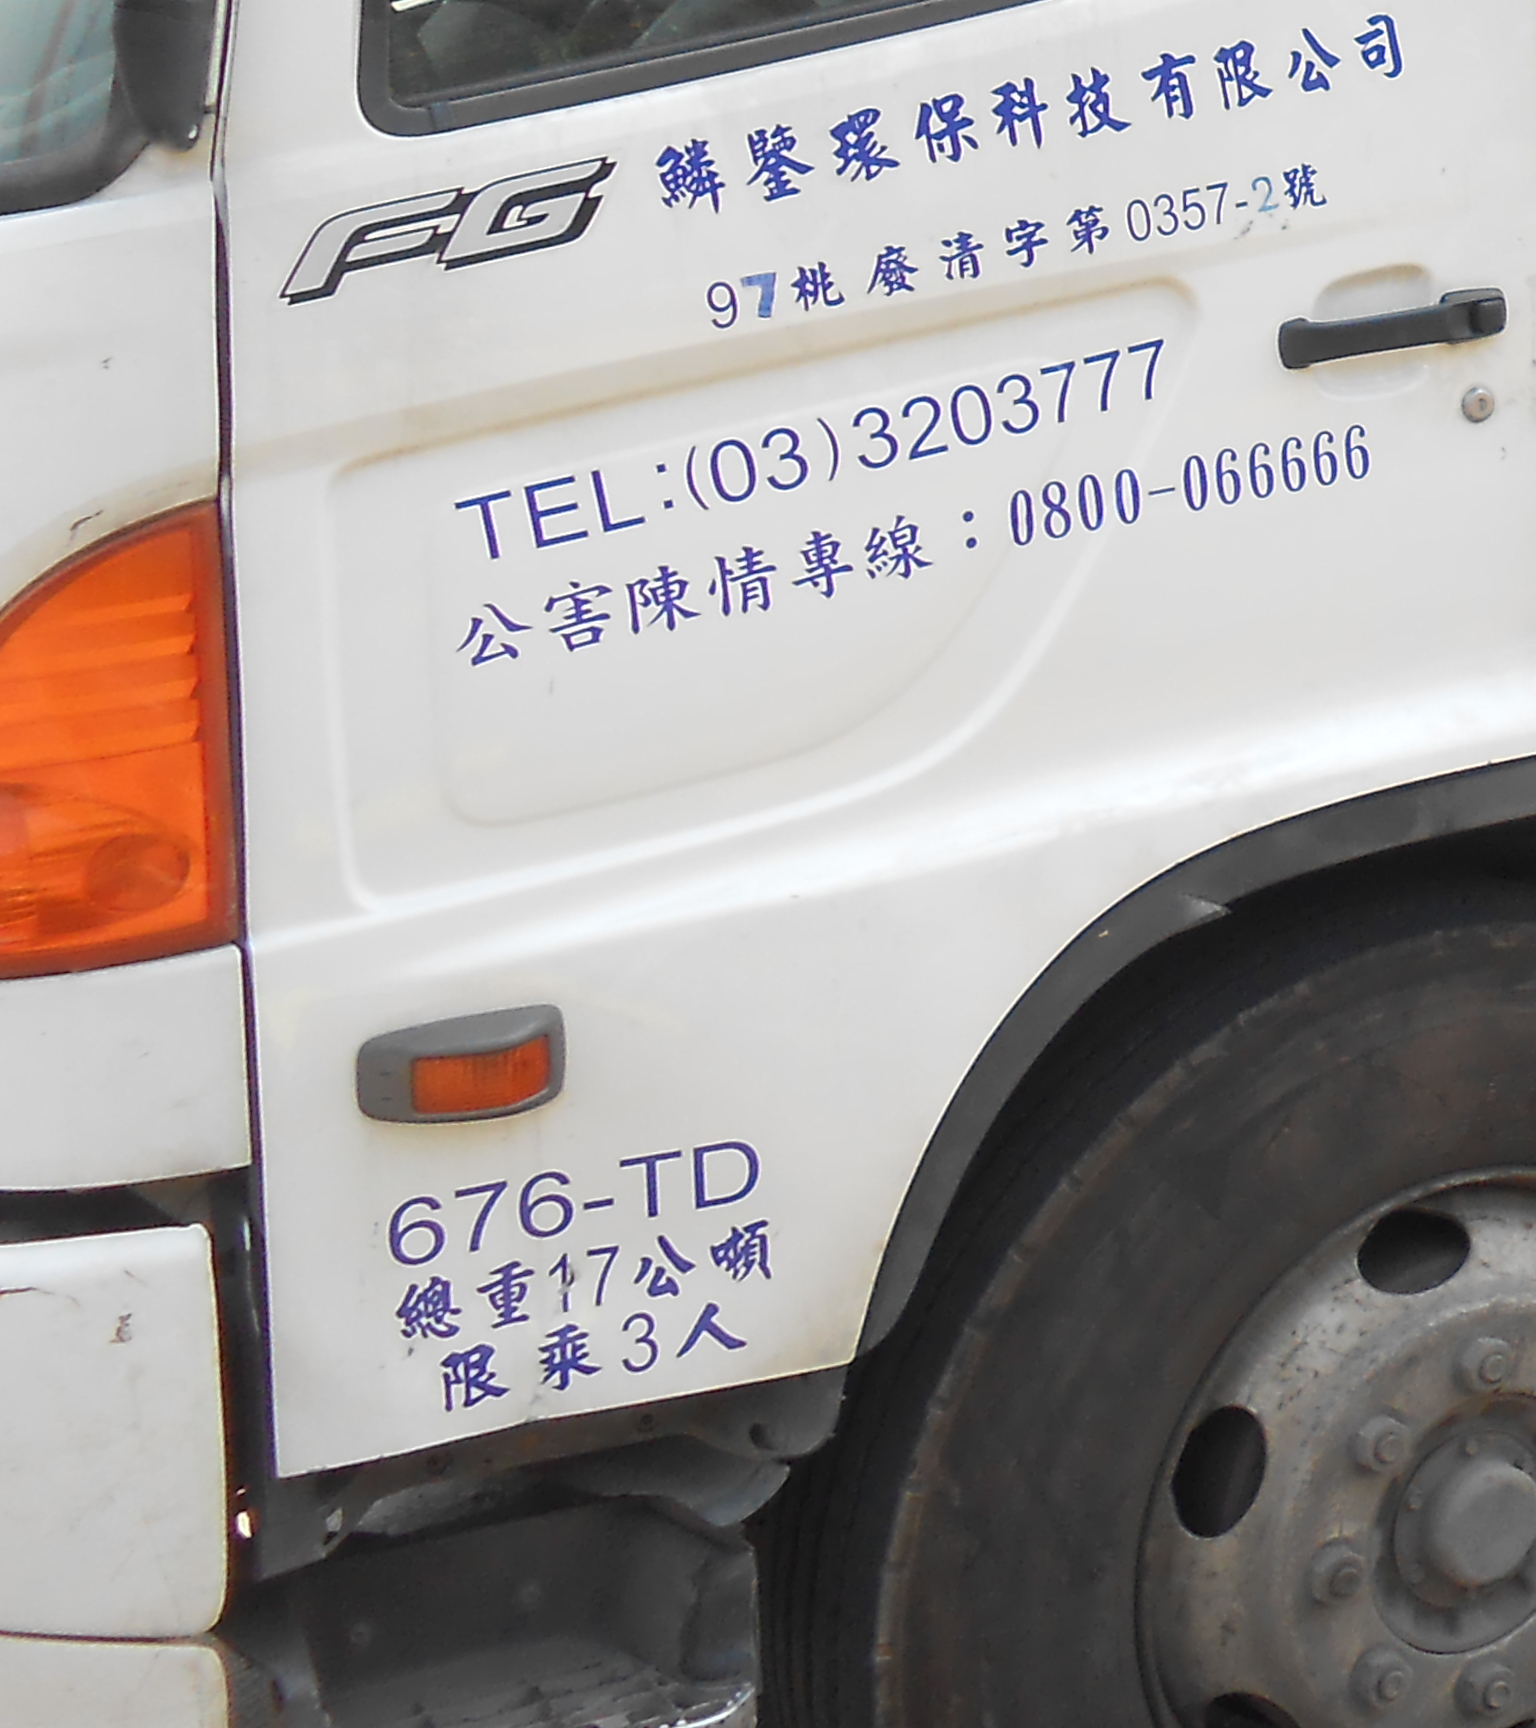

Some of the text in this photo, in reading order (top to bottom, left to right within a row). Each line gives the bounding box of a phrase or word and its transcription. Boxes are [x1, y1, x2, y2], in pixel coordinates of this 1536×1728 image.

[279, 156, 617, 305] FG
[455, 339, 1164, 560] TEL:(03)3203777
[387, 1139, 762, 1266] 676-TD
[440, 1303, 747, 1412] 限乘3人
